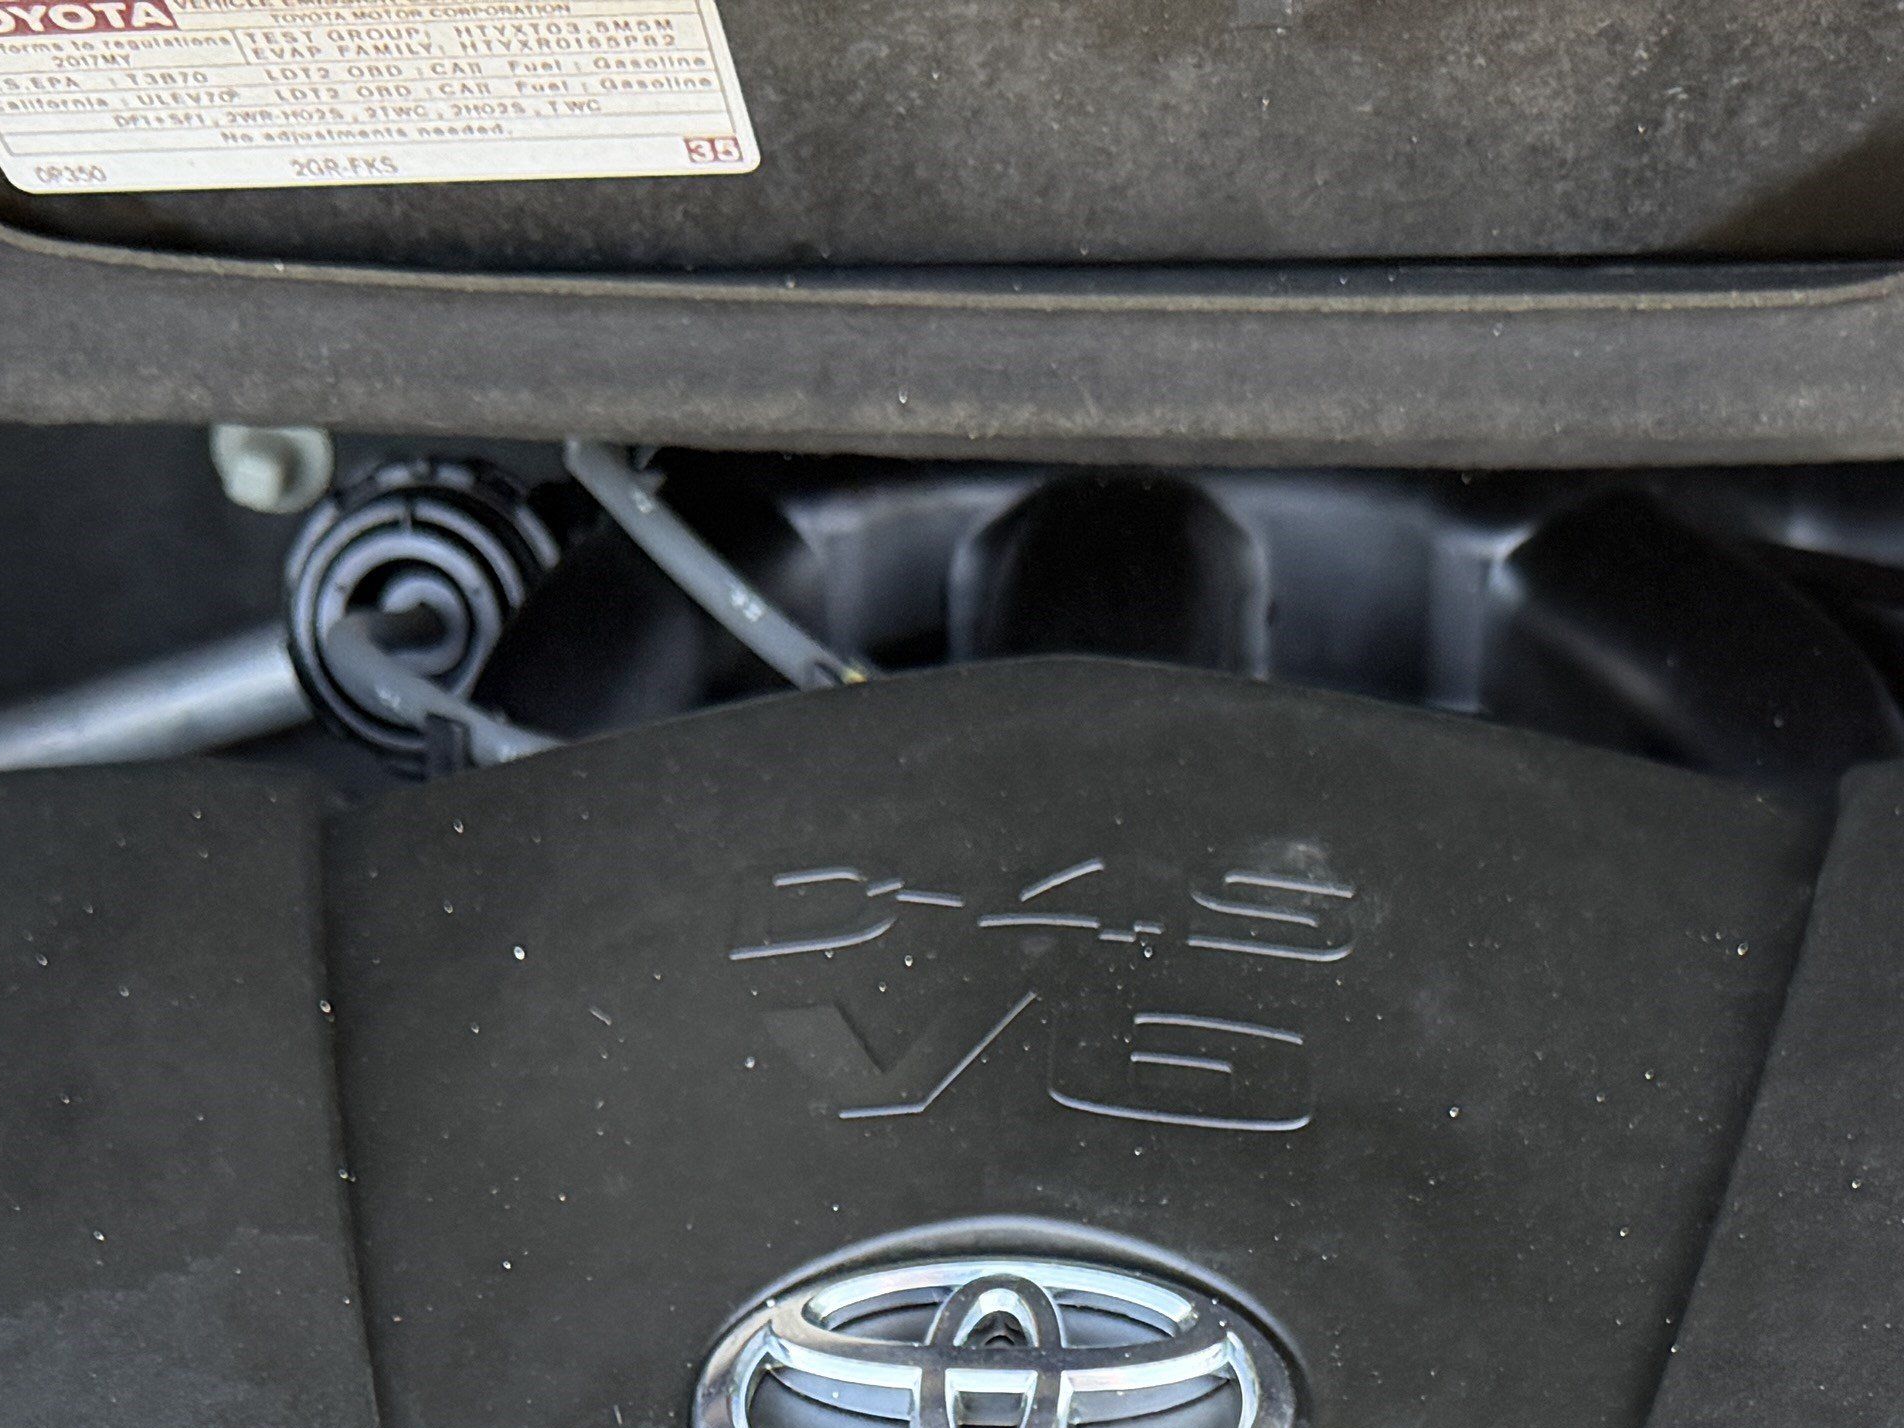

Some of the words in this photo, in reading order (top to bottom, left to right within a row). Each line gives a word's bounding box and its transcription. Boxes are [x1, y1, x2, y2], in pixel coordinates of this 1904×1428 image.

[270, 11, 347, 25] TOYOTA
[351, 8, 423, 21] MOTOR
[429, 3, 572, 19] CORPORATION
[70, 40, 95, 54] to
[101, 34, 232, 53] regulations
[245, 28, 314, 46] TEST
[251, 45, 323, 61] EVAP
[507, 58, 563, 74] Fuel
[593, 55, 706, 70] Gasoline
[515, 78, 570, 94] Fuel
[600, 76, 713, 91] Gasoline
[220, 129, 255, 144] No
[262, 124, 409, 145] adjustments
[763, 990, 1312, 1133] V6
